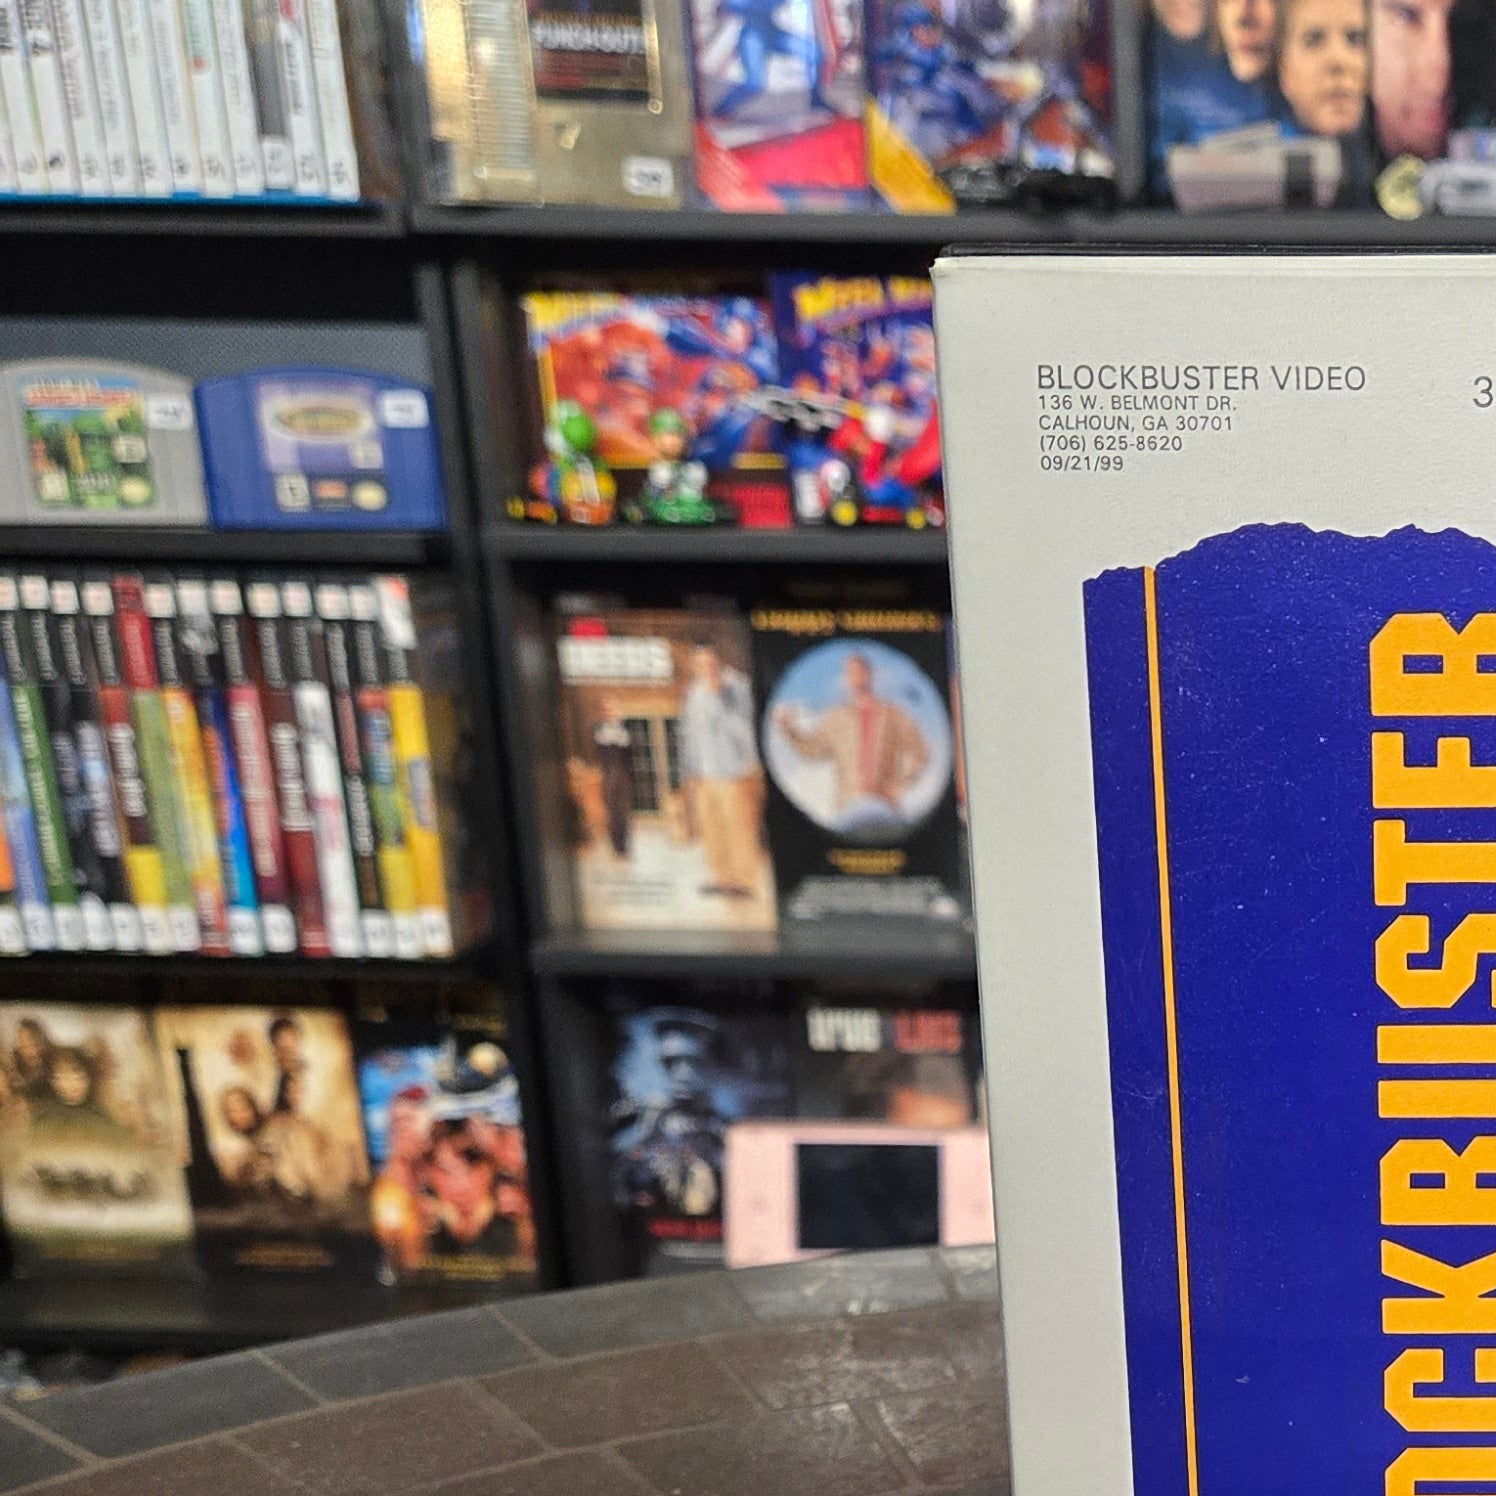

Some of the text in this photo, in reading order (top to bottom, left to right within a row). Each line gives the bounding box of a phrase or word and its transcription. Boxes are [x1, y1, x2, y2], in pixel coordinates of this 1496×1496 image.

[1037, 364, 1367, 391] BLOCKBUSTER VIDEO
[1038, 395, 1238, 412] 136 W. BELMONT DR.
[1038, 415, 1232, 433] CALHOUN, GA 30701
[1039, 435, 1183, 452] (706) 625-8620
[1040, 456, 1124, 472] 09/21/99
